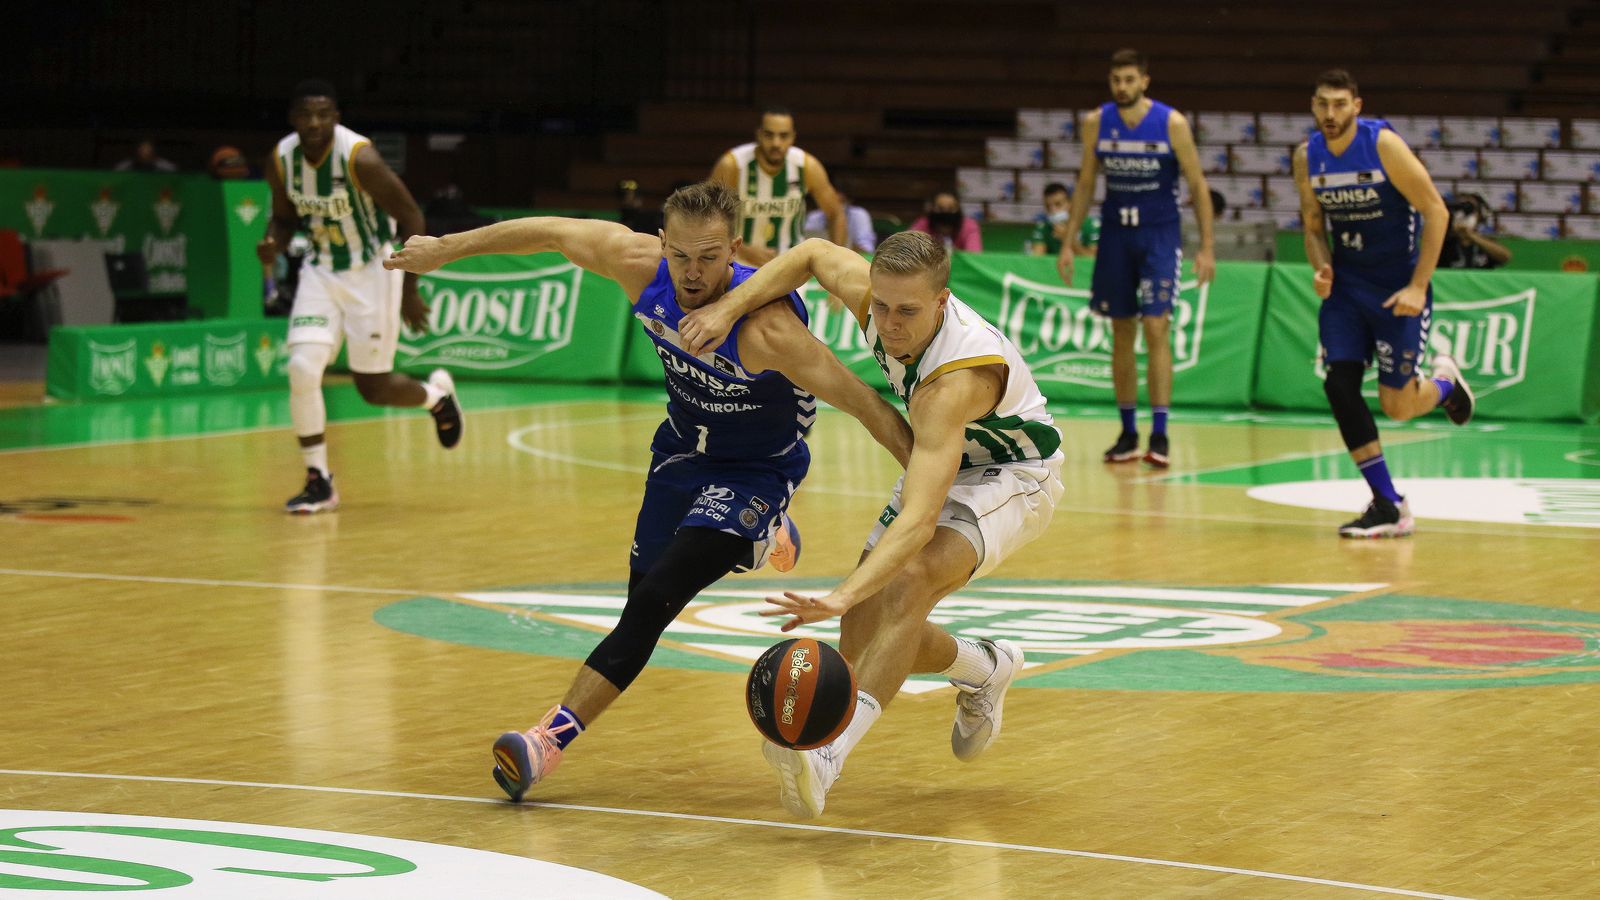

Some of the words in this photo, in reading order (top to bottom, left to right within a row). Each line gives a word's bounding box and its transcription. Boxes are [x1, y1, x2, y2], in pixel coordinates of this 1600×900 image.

[1119, 206, 1139, 226] 11
[695, 425, 709, 454] 1
[751, 500, 763, 511] acb
[705, 508, 725, 522] Car
